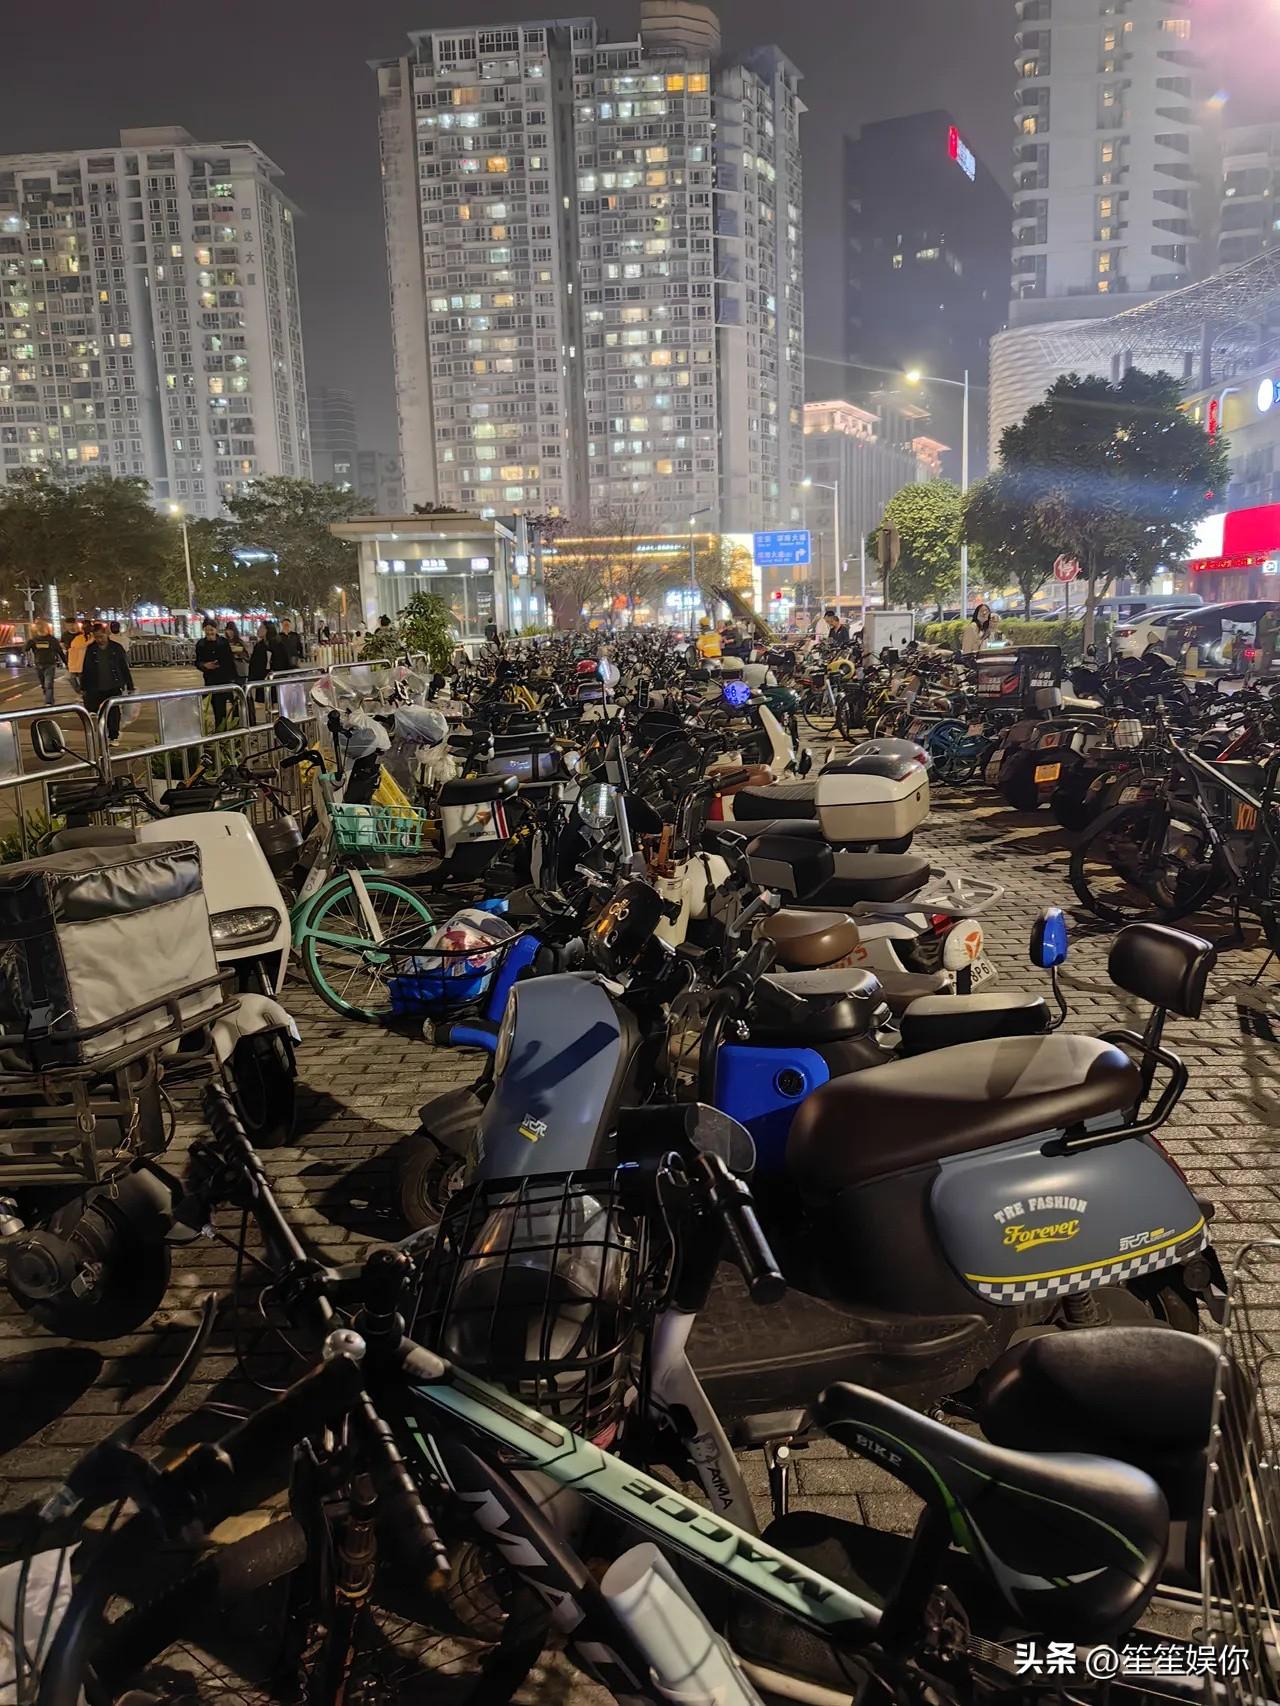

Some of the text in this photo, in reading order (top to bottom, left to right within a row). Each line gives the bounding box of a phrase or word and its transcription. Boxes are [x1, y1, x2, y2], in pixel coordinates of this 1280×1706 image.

[1028, 1196, 1088, 1214] FASHION
[1003, 1218, 1081, 1252] Forever
[856, 1434, 902, 1466] BIKE
[705, 1464, 734, 1511] AIMA
[621, 1478, 836, 1605] MACCE
